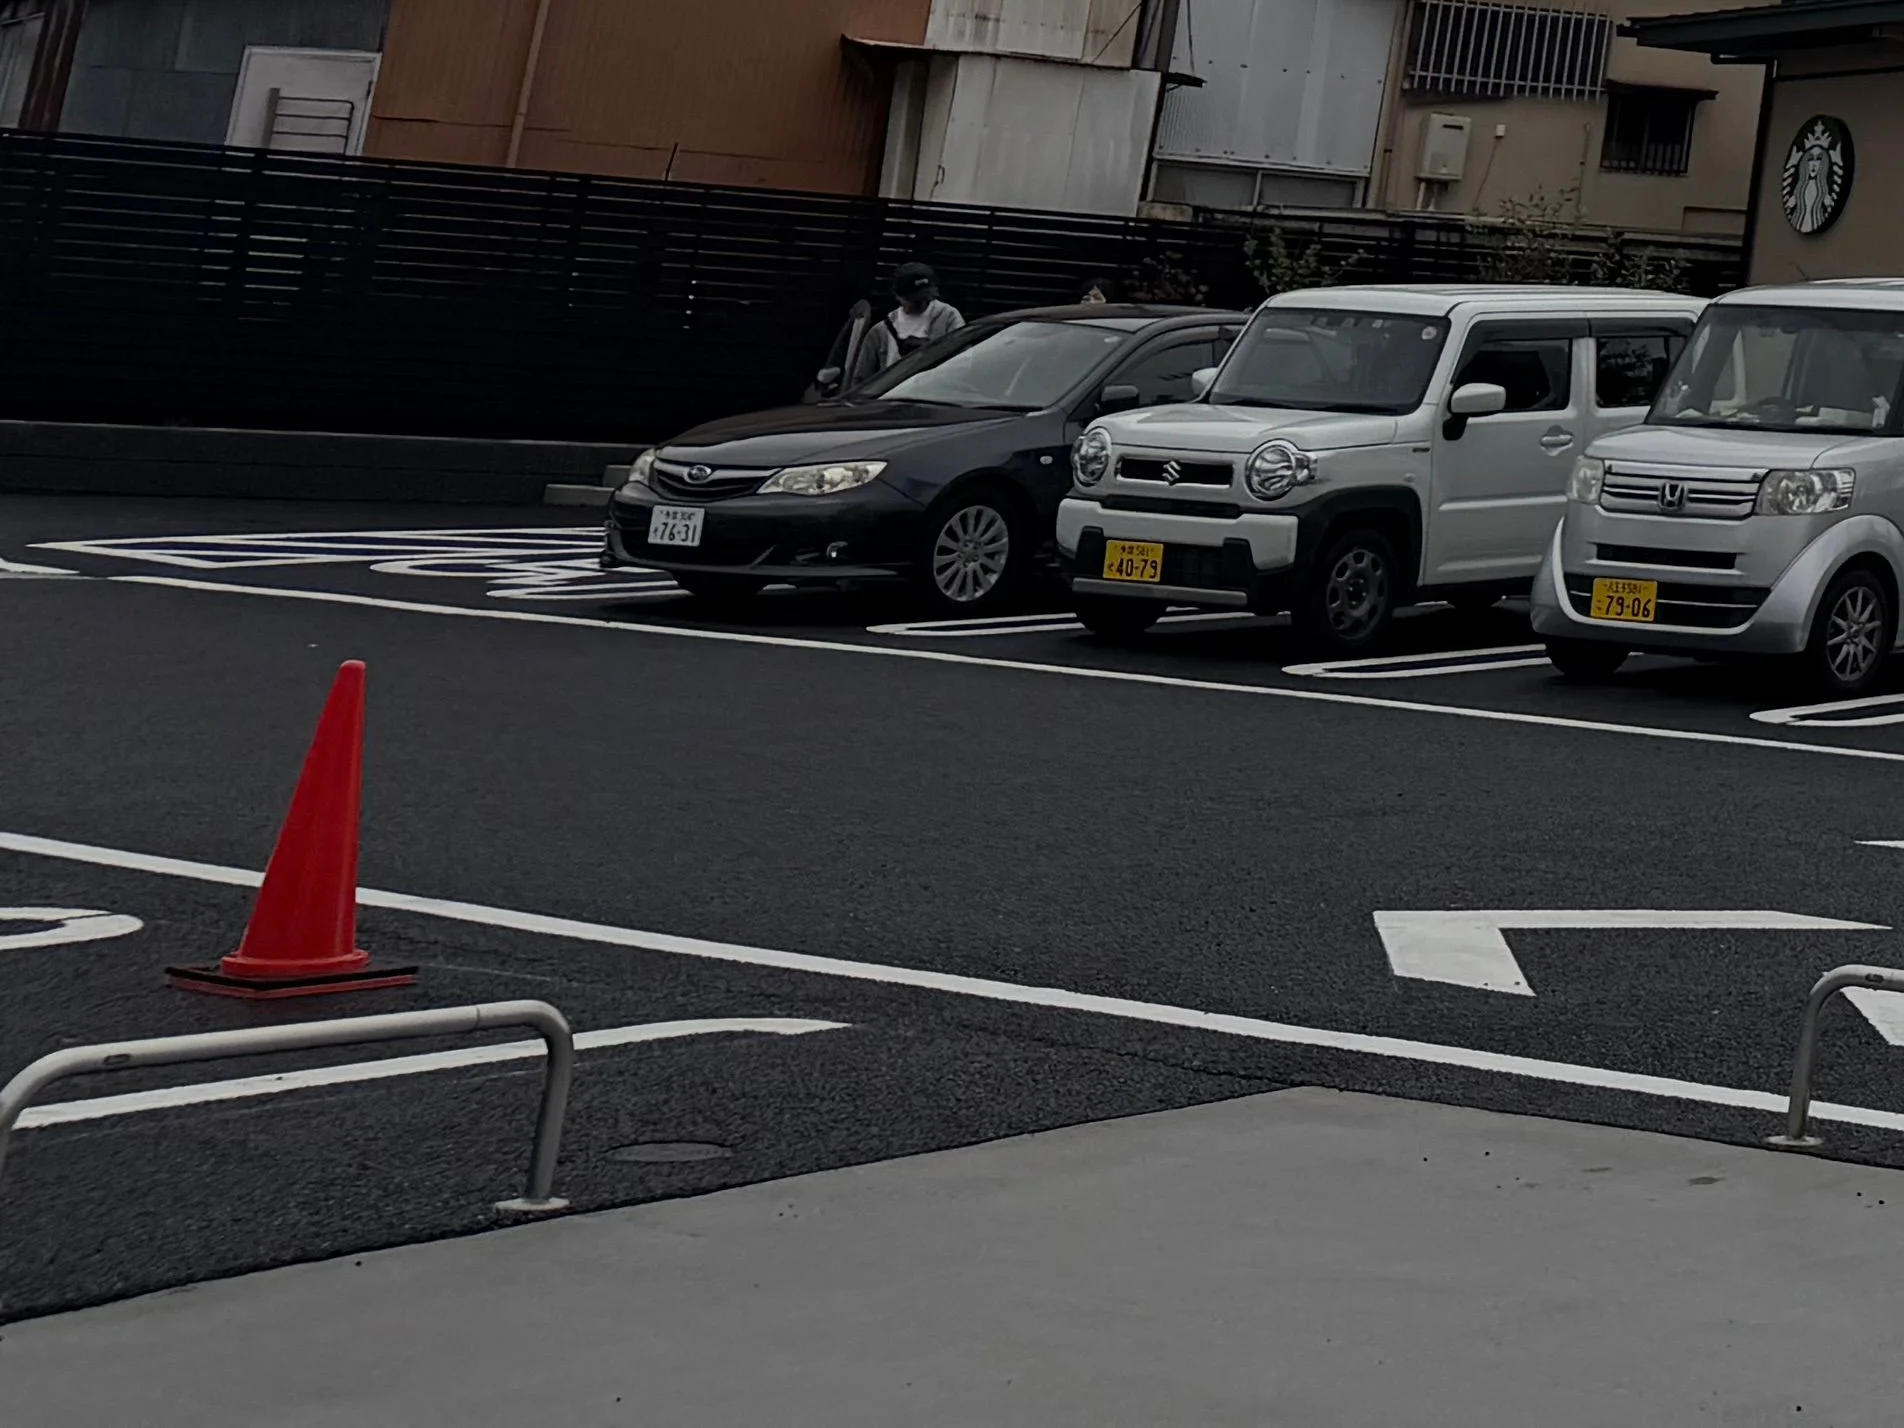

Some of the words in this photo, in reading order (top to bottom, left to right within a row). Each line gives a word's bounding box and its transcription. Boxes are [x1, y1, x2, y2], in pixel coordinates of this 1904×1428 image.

[660, 522, 697, 543] 76-31
[1116, 558, 1158, 579] 40-79
[1605, 595, 1652, 618] 79-06
